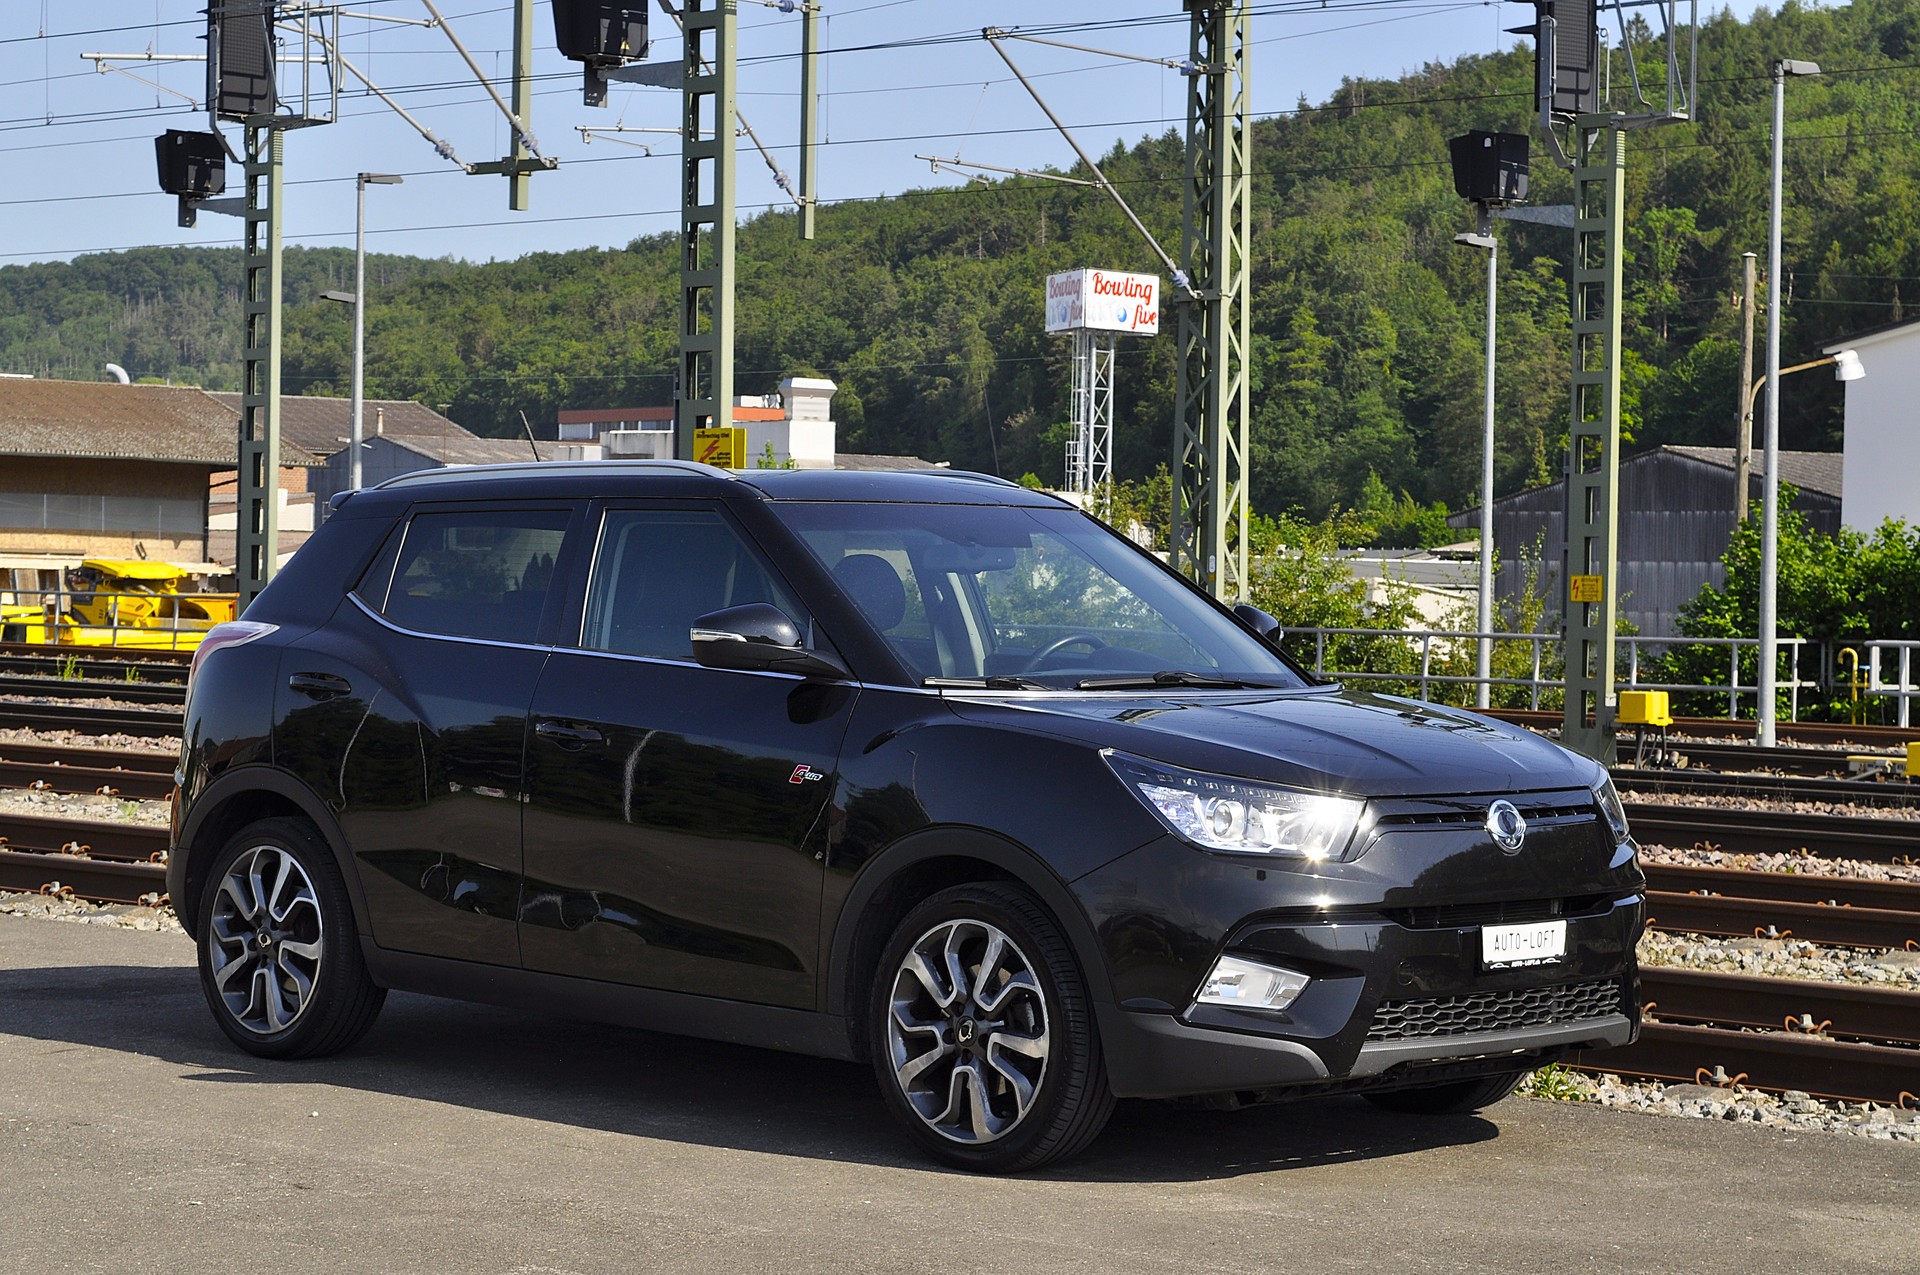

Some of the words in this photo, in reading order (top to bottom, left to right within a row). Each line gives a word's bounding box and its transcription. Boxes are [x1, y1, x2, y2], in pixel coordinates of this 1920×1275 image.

[1049, 275, 1081, 301] Bowling
[1092, 272, 1153, 306] Bowling
[1131, 304, 1158, 330] five
[1494, 929, 1555, 951] AUTO-LOFT
